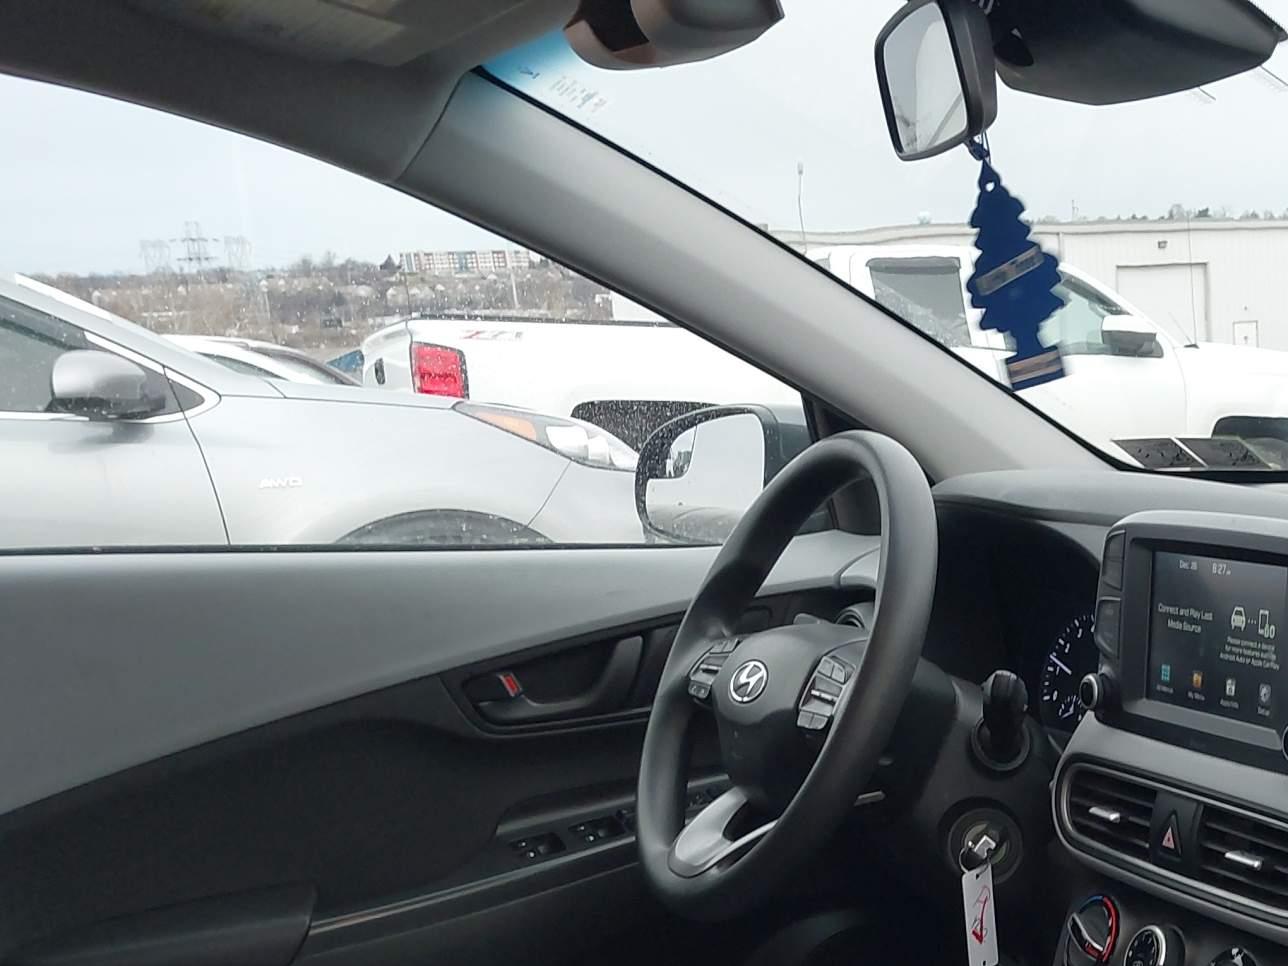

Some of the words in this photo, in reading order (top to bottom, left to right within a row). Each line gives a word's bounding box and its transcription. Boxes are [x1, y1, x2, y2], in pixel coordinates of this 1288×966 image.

[259, 478, 303, 489] AWD
[1158, 603, 1179, 615] Connect
[1179, 607, 1190, 617] and
[1189, 608, 1201, 620] Play
[1201, 610, 1213, 621] Last
[1167, 619, 1183, 630] Media
[1183, 621, 1202, 634] Source
